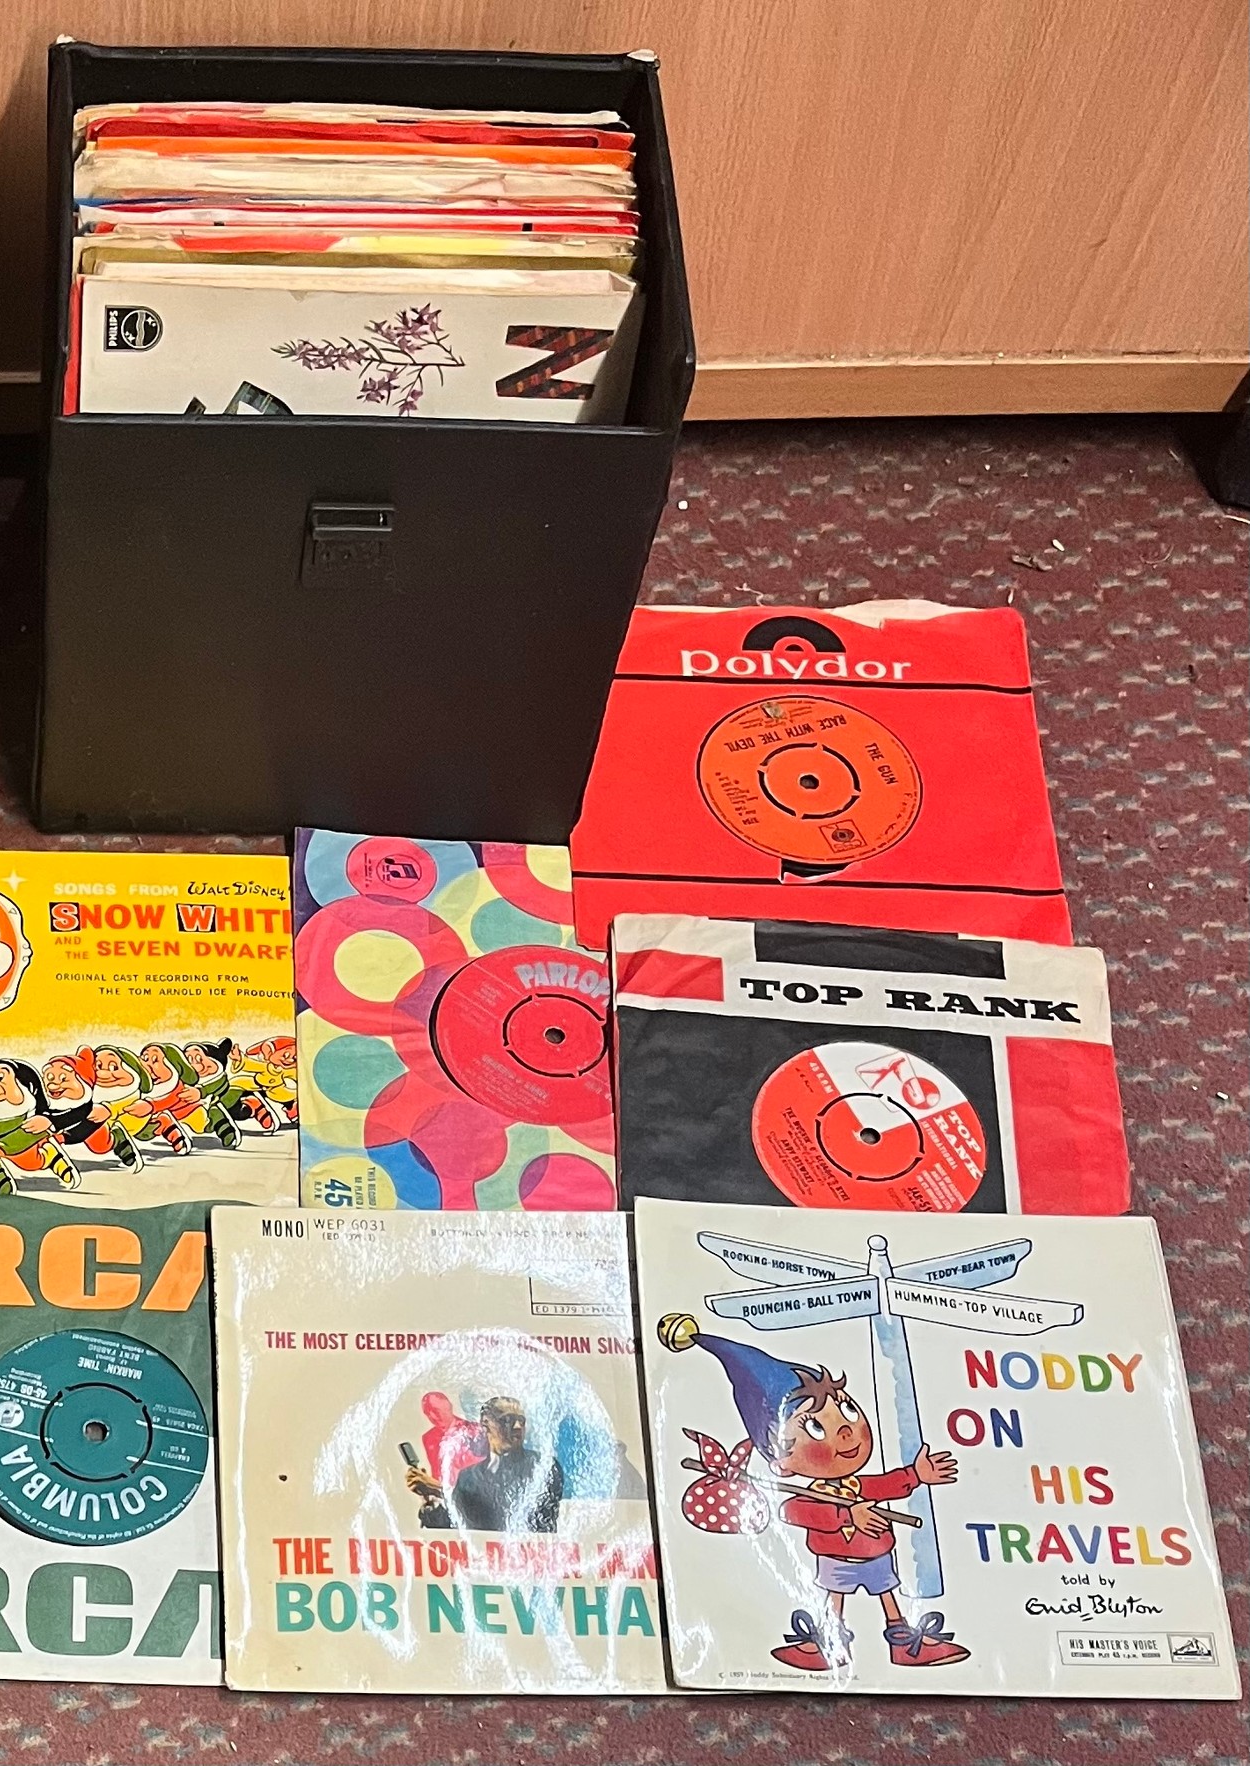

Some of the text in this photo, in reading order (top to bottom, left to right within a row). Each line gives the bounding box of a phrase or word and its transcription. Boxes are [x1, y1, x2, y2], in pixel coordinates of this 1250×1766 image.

[108, 310, 119, 347] PHILIPS
[786, 723, 815, 739] WITH
[819, 714, 848, 731] RACE
[724, 737, 756, 753] DEVIL
[761, 730, 782, 745] THE
[865, 742, 884, 762] THE
[877, 764, 899, 786] GUN
[54, 882, 117, 896] SONGS
[129, 883, 179, 896] FROM
[49, 902, 165, 932] SNOW
[55, 936, 82, 946] AND
[65, 940, 293, 961] THE SEVEN DWARF
[56, 973, 249, 983] ORIGINAL CAST RECORDING FROM
[99, 987, 121, 995] THE
[128, 987, 151, 996] TOM
[159, 988, 202, 996] ARNOLD
[209, 988, 227, 997] ICE
[740, 977, 1081, 1024] TOP RANK
[948, 1110, 982, 1152] TOP
[933, 1115, 983, 1180] RANK
[324, 1178, 353, 1207] 45
[262, 1219, 305, 1238] MONO
[313, 1219, 345, 1231] WEP
[722, 1249, 836, 1282] ROCKING-HORSE TOWN
[925, 1253, 1017, 1282] TEDDY-BEAR TOWN
[742, 1289, 872, 1318] BOUNCING-BALL TOWN
[894, 1291, 1044, 1325] HUMMING-TOP VILLAGE
[264, 1331, 297, 1350] THE
[303, 1332, 349, 1351] MOST
[78, 1357, 100, 1371] TIME
[104, 1363, 143, 1380] MARKIN'
[965, 1349, 1143, 1393] NODDY
[947, 1407, 1024, 1448] ON
[0, 1444, 168, 1522] COLUMBIA
[1030, 1464, 1114, 1505] HIS
[273, 1537, 333, 1575] THE
[965, 1522, 1192, 1566] TRAVELS
[1061, 1574, 1115, 1588] told by
[275, 1581, 656, 1637] BOB NEWHA
[1025, 1594, 1164, 1618] Enid Blyton
[1069, 1639, 1159, 1650] HIS MASTER'S VOICE
